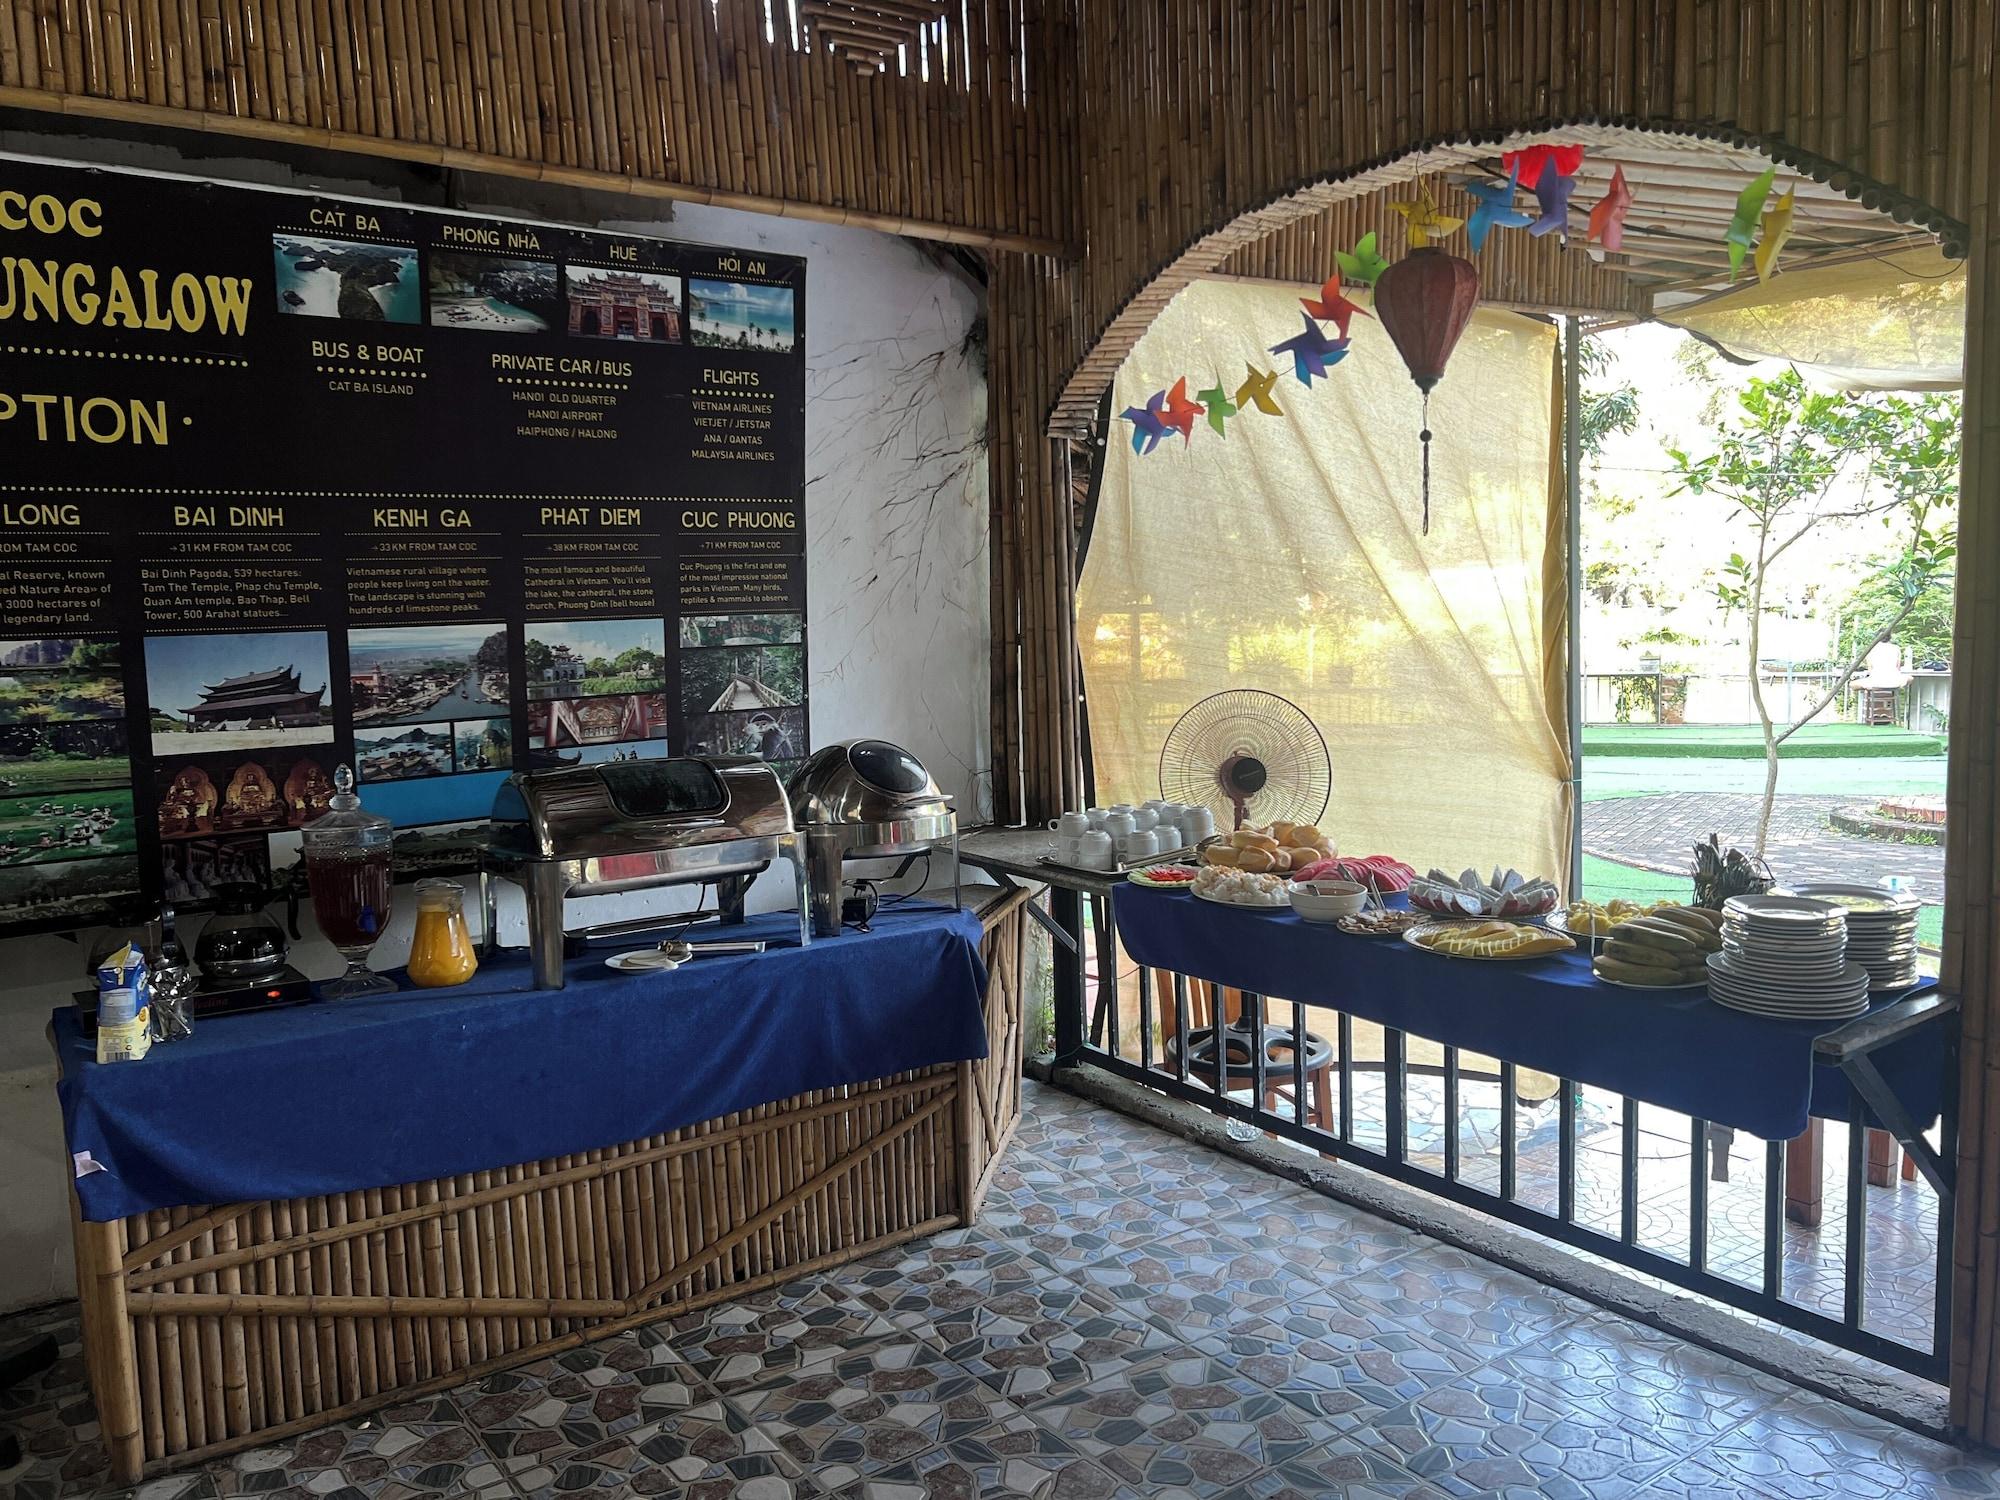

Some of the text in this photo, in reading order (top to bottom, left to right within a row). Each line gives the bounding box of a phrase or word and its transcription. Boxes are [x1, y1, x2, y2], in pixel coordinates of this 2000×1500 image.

[0, 190, 102, 238] COC
[310, 209, 380, 232] CAT BA
[443, 225, 499, 246] PHONG
[718, 257, 766, 275] HOI AN
[312, 341, 423, 364] BUS & BOAT
[492, 354, 554, 372] PRIVATE
[704, 369, 759, 386] FLIGHTS
[329, 382, 413, 395] CAT BA ISLAND
[513, 391, 616, 405] HANOI OLD QUARTER
[692, 402, 772, 414] VIETNAM AIRLINES
[528, 409, 603, 422] HANOI AIRPORT
[694, 417, 770, 430] VIETJET JETSTAR
[517, 426, 617, 439] HAIPHONG HALONG
[704, 435, 762, 445] ANA QANTAS
[692, 450, 775, 461] MALAYSIA AIRLINES
[3, 504, 81, 526] LONG
[175, 507, 283, 526] BAI DINH
[373, 509, 471, 527] KENH GA
[541, 508, 641, 526] PHAT DIEM
[682, 511, 795, 528] CUC PHUONG
[25, 543, 77, 552] TAM COC
[179, 543, 292, 552] 31 KM FROM TAM COC
[380, 543, 391, 551] 33
[392, 543, 406, 551] KM
[409, 543, 435, 551] FROM
[346, 568, 401, 576] Vietnamese
[428, 567, 457, 576] village
[524, 566, 539, 574] The
[695, 563, 722, 571] Phuong
[13, 570, 105, 580] Reserve, known
[142, 570, 158, 578] Bai
[162, 569, 186, 578] Dinh
[190, 569, 231, 580] Pagoda,
[234, 569, 252, 578] 539
[20, 584, 111, 594] Nature of
[142, 582, 322, 593] Tam The Temple, Phap chu Temple,
[348, 580, 378, 590] people
[381, 580, 403, 589] keep
[406, 580, 429, 588] living
[743, 584, 760, 592] Many
[368, 593, 414, 602] landscape
[427, 592, 464, 600] stunning
[577, 589, 617, 597] cathedral,
[6, 599, 33, 609] 3000
[37, 599, 87, 608] hectares
[90, 598, 101, 608] of
[144, 595, 309, 607] Quan Am temple, Bao Thap, Bell
[558, 601, 588, 610] Phuong
[591, 600, 608, 608] Dinh
[349, 606, 392, 614] hundreds
[406, 604, 450, 612] limestone
[453, 603, 480, 612] peaks.
[3, 613, 93, 625] legendary land.
[145, 610, 240, 620] Tower, 500 Arahat
